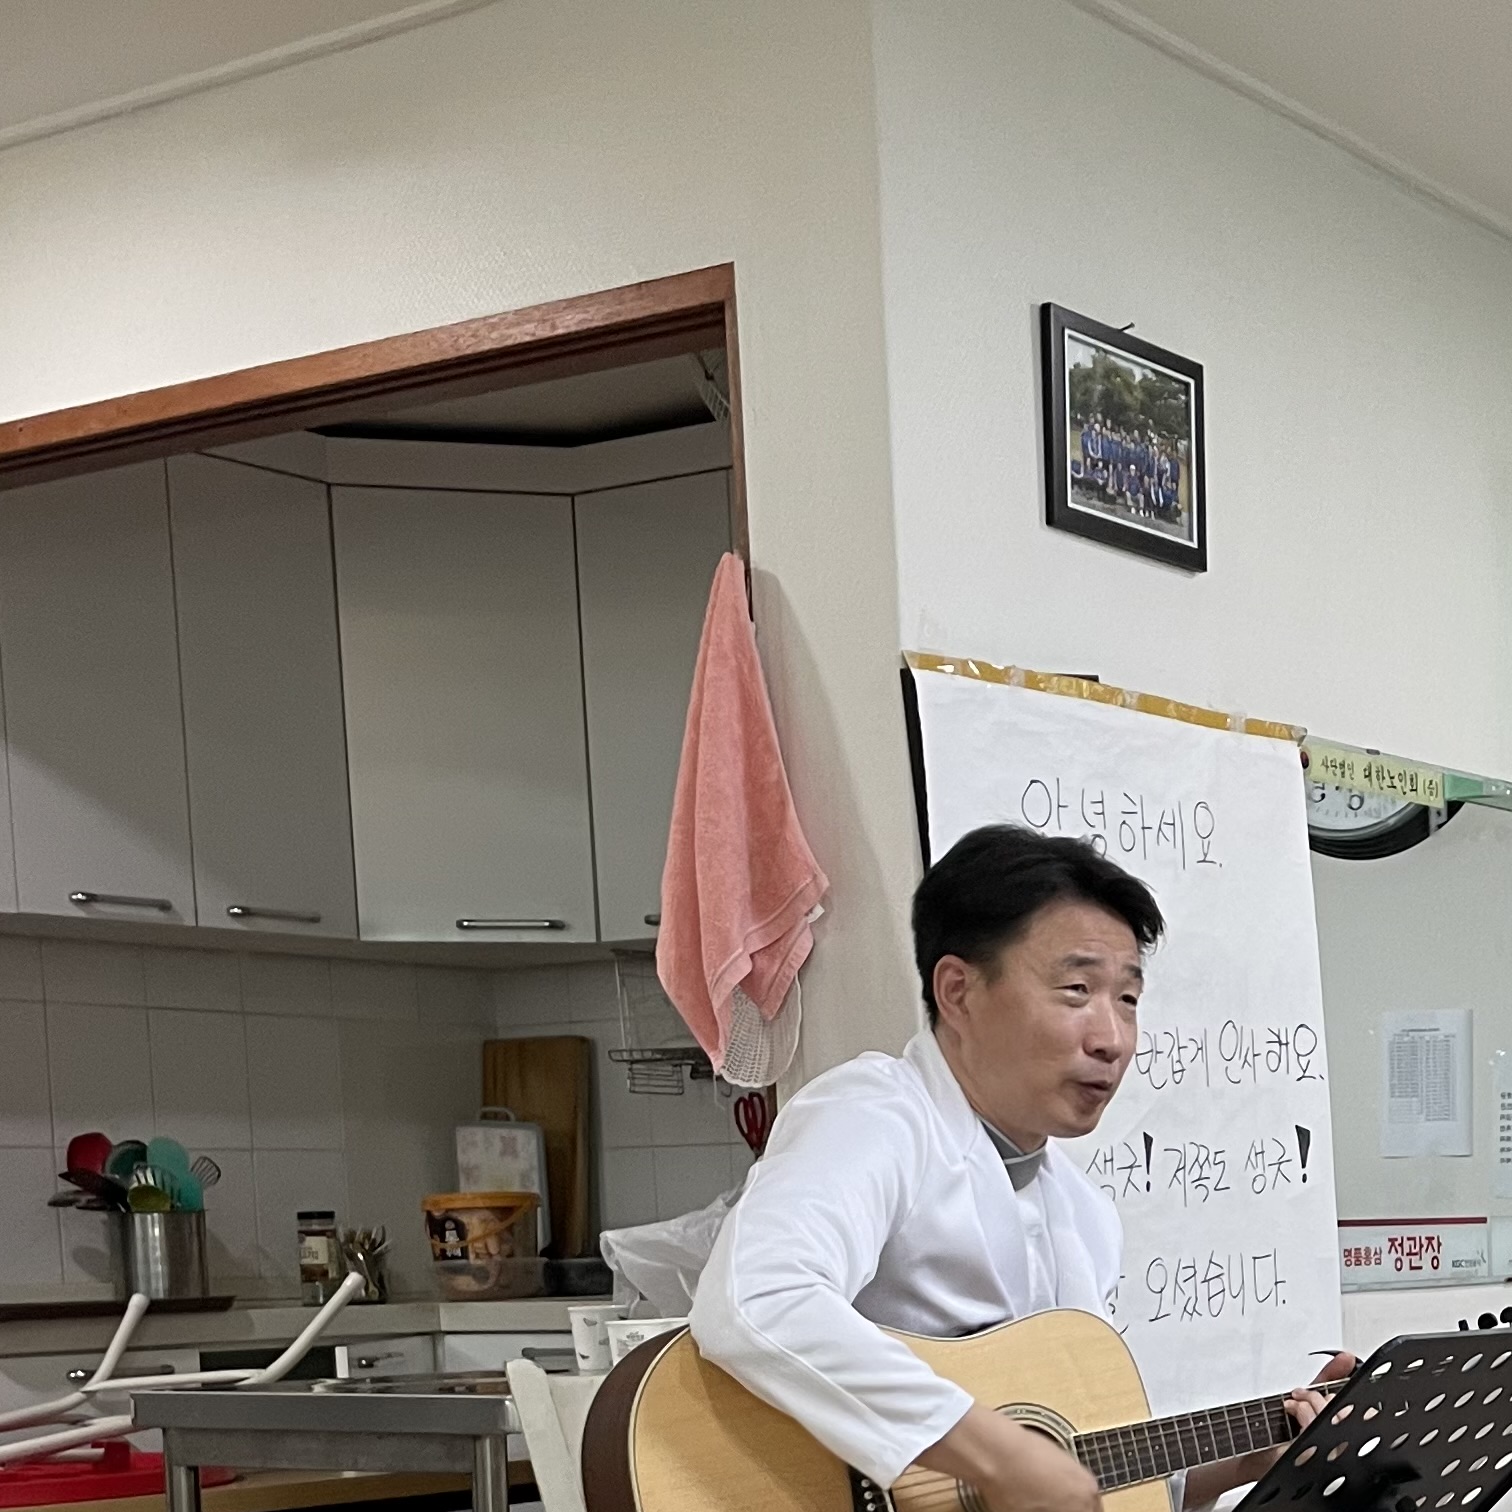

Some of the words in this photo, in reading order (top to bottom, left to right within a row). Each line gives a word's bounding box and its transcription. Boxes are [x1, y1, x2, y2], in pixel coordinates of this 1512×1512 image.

[1321, 756, 1354, 780] 사단법인
[1364, 762, 1418, 796] 대한노인회
[1136, 1026, 1209, 1090] 반갑게
[1219, 1020, 1325, 1084] 인사해요.
[1164, 1141, 1231, 1208] 저쪽도
[1244, 1124, 1311, 1194] 생긋!
[1146, 1248, 1287, 1323] 오셨습니다.
[1343, 1247, 1382, 1268] 명품홍삼
[1388, 1235, 1442, 1272] 정관장
